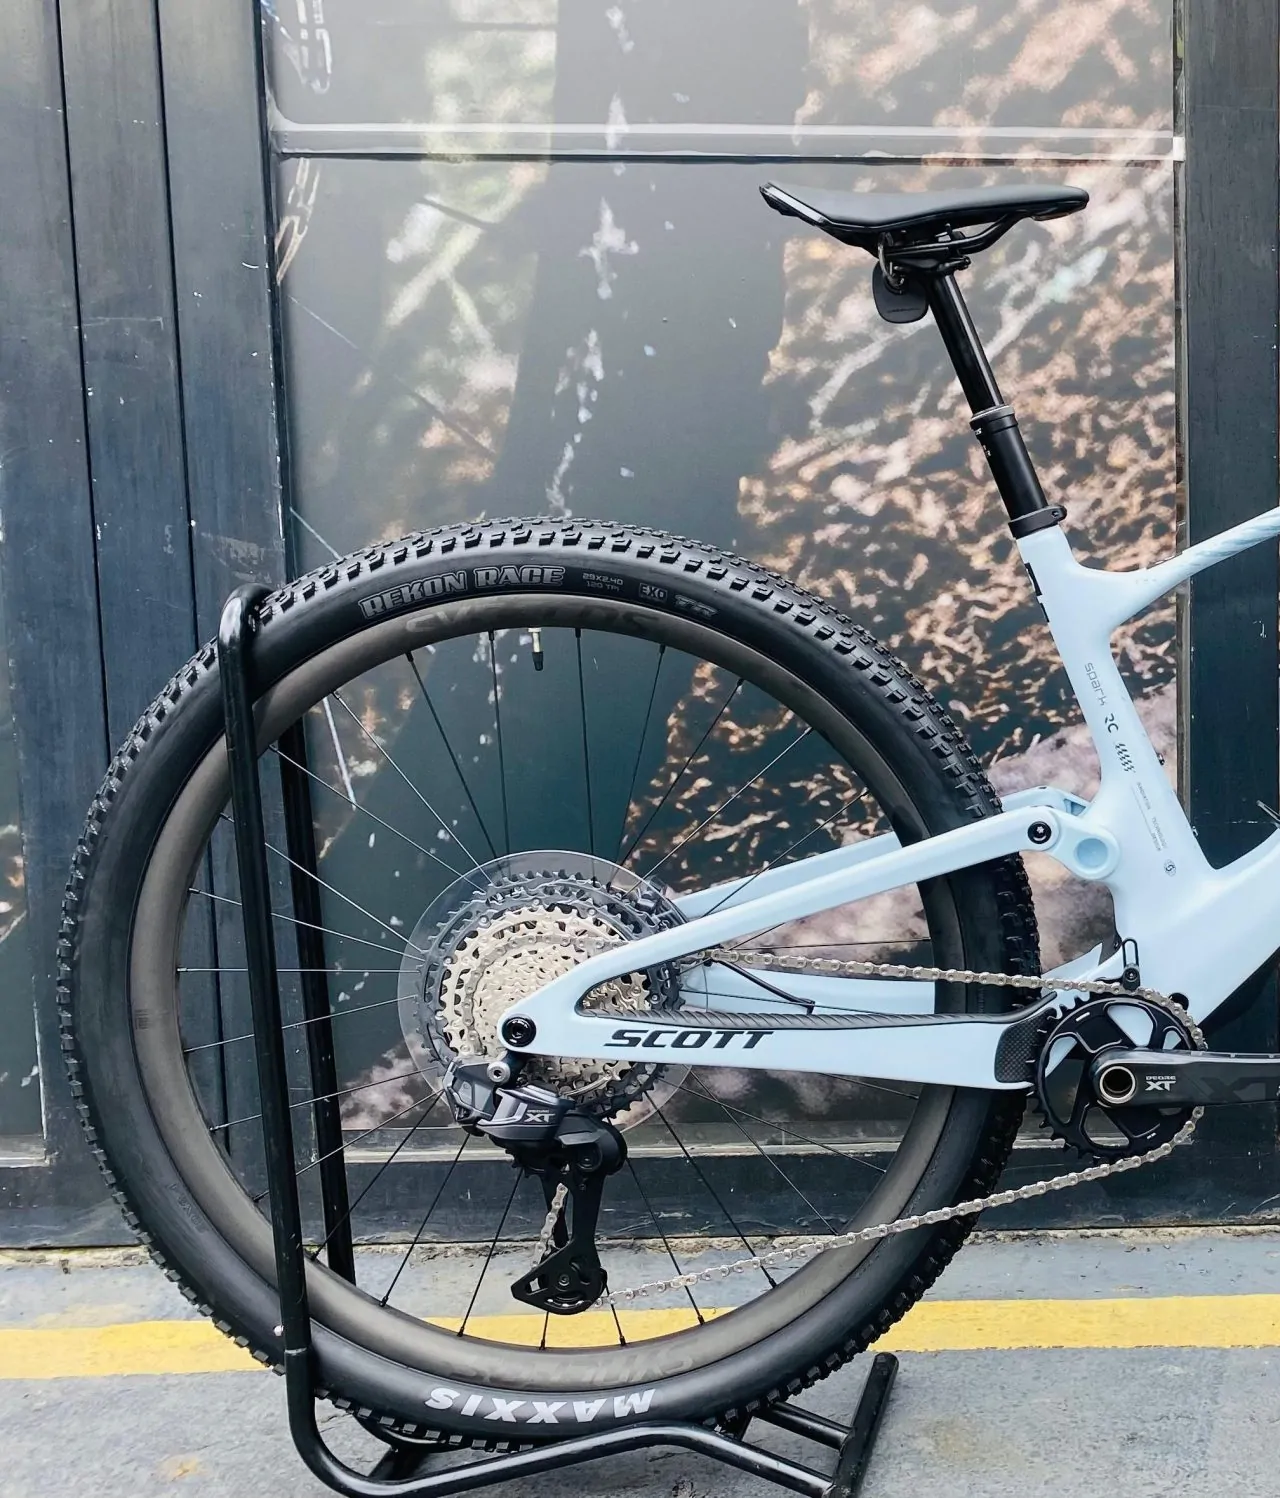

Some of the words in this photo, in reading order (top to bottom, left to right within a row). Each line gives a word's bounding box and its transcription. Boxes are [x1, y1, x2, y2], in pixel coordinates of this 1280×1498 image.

[358, 571, 468, 618] REKON
[473, 565, 566, 588] RACE
[639, 582, 667, 601] EXO
[604, 1029, 775, 1049] SCOTT
[1144, 1080, 1177, 1092] XT
[523, 1113, 556, 1123] XT
[425, 1387, 656, 1424] MAXXIS
